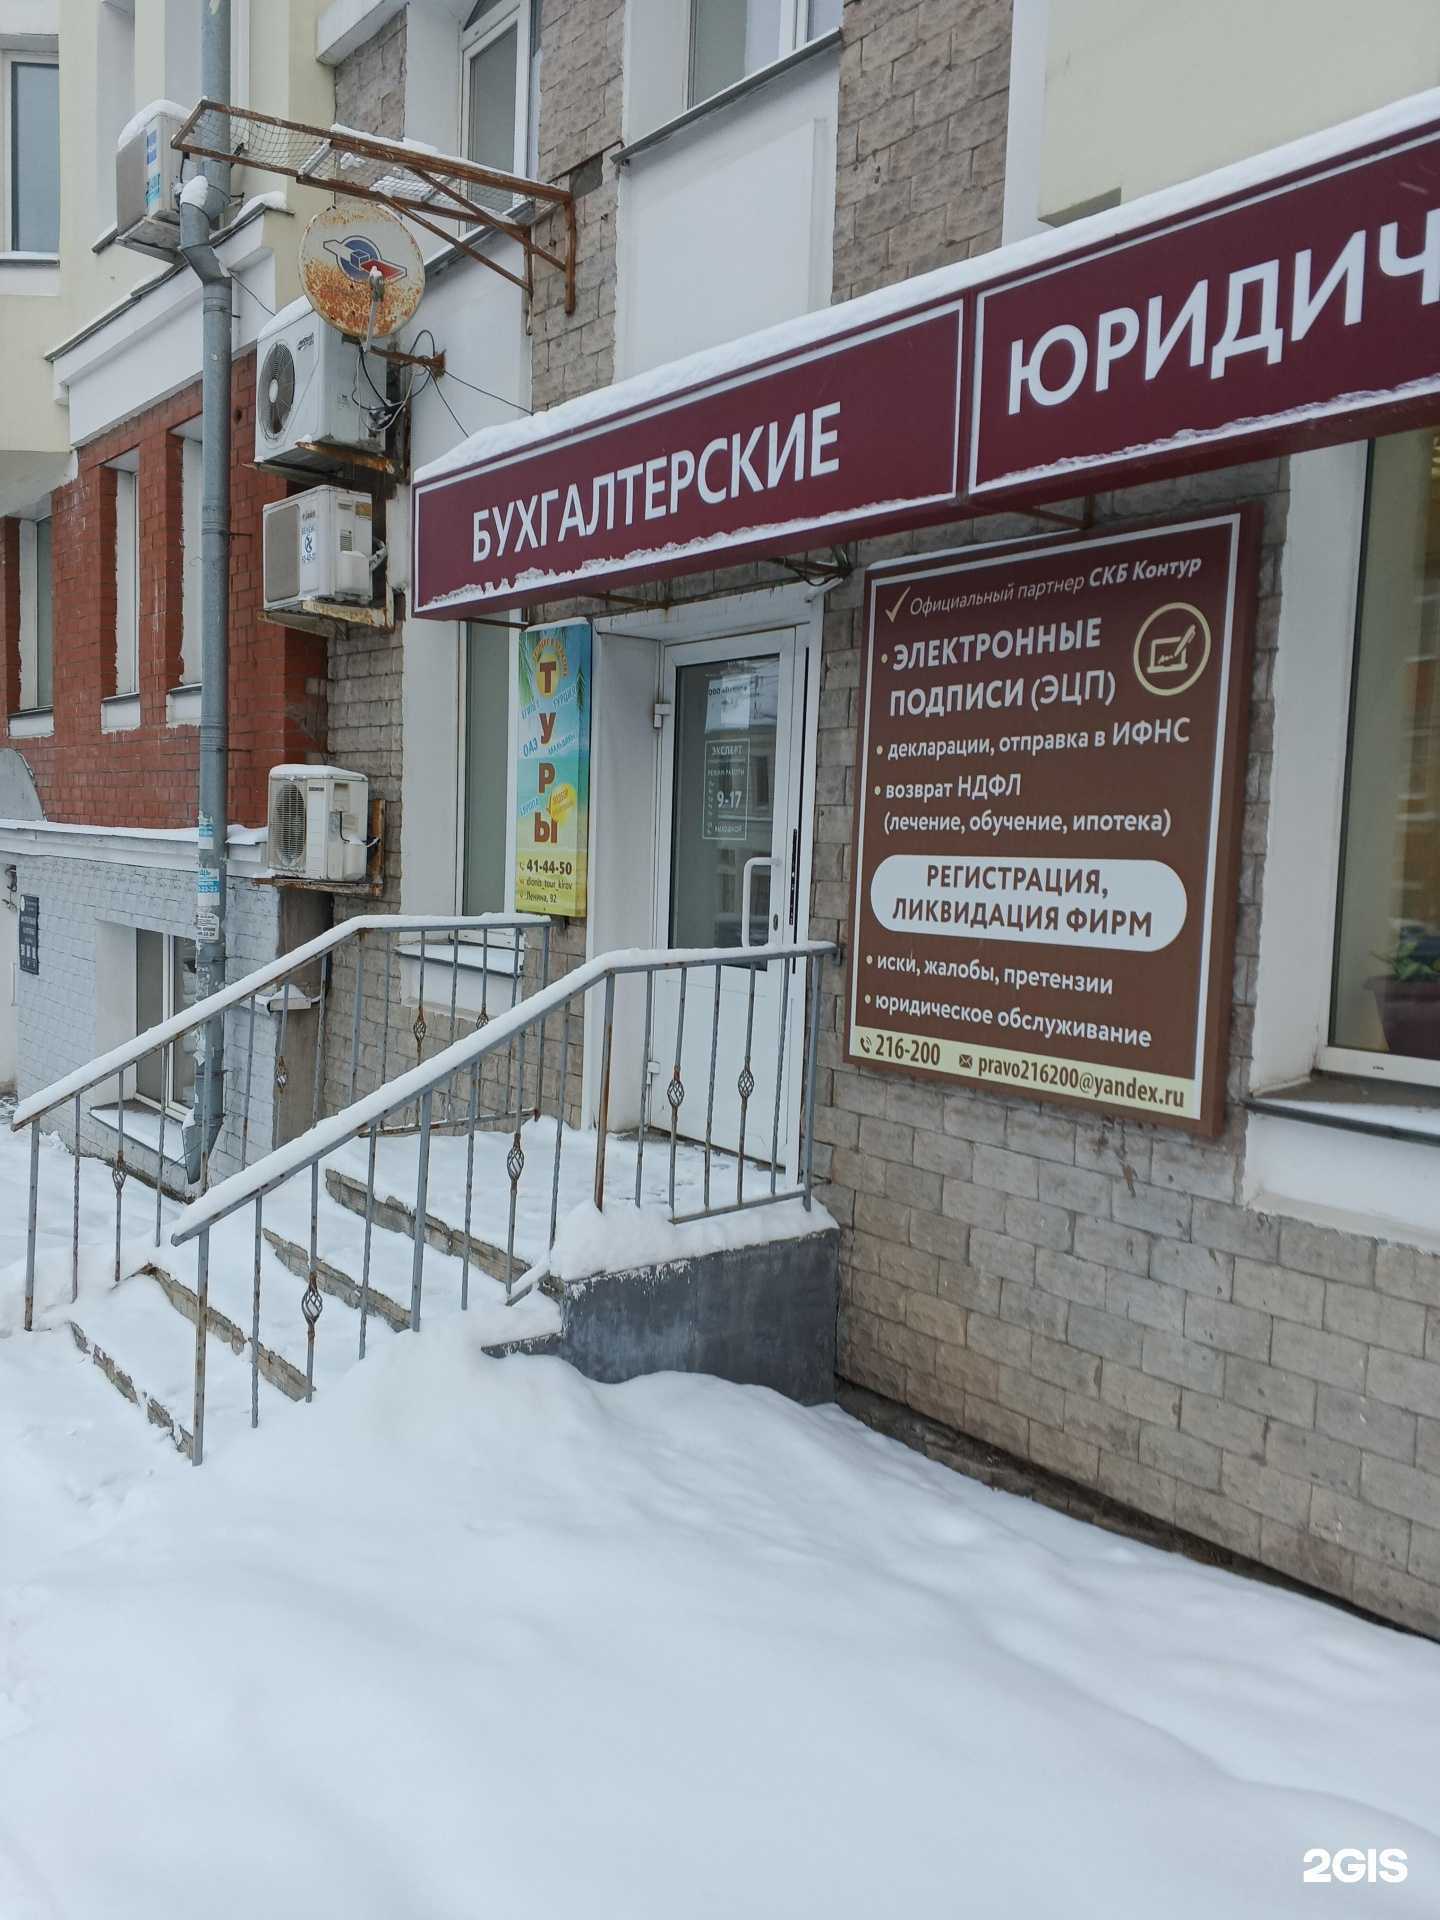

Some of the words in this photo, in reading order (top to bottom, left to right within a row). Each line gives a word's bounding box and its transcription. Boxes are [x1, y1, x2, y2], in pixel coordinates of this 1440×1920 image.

[1008, 208, 1440, 415] ЮРИДИЧ
[473, 401, 841, 563] БУХГАЛТЕРСКИЕ
[910, 585, 1014, 617] Официальный
[1017, 575, 1084, 598] партнер
[1089, 564, 1127, 587] СКБ
[1133, 557, 1202, 582] Контур
[893, 617, 1102, 671] ЭЛЕКТРОННЫЕ
[890, 678, 1024, 717] ПОДПИСИ
[1031, 670, 1116, 711] (ЭЦП)
[888, 737, 995, 760] декларации,
[999, 728, 1088, 756] отправка
[1095, 729, 1106, 747] в
[1112, 717, 1191, 747] ИФНС
[885, 781, 953, 803] возврат
[957, 773, 1022, 799] НДФЛ
[884, 810, 966, 835] (лечение,
[969, 809, 1068, 838] обучение,
[1073, 808, 1171, 837] ипотека)
[526, 859, 573, 875] 41-44-50
[926, 864, 1109, 898] РЕГИСТРАЦИЯ,
[892, 897, 1059, 932] ЛИКВИДАЦИЯ
[1066, 906, 1152, 938] ФИРМ
[877, 953, 920, 976] иски,
[924, 958, 1000, 984] жалобы,
[1004, 967, 1114, 995] претензии
[875, 994, 993, 1025] юридическое
[998, 1007, 1152, 1048] обслуживание
[875, 1033, 941, 1066] 216-200
[978, 1054, 1185, 1108] pravo216200@yandex.ru
